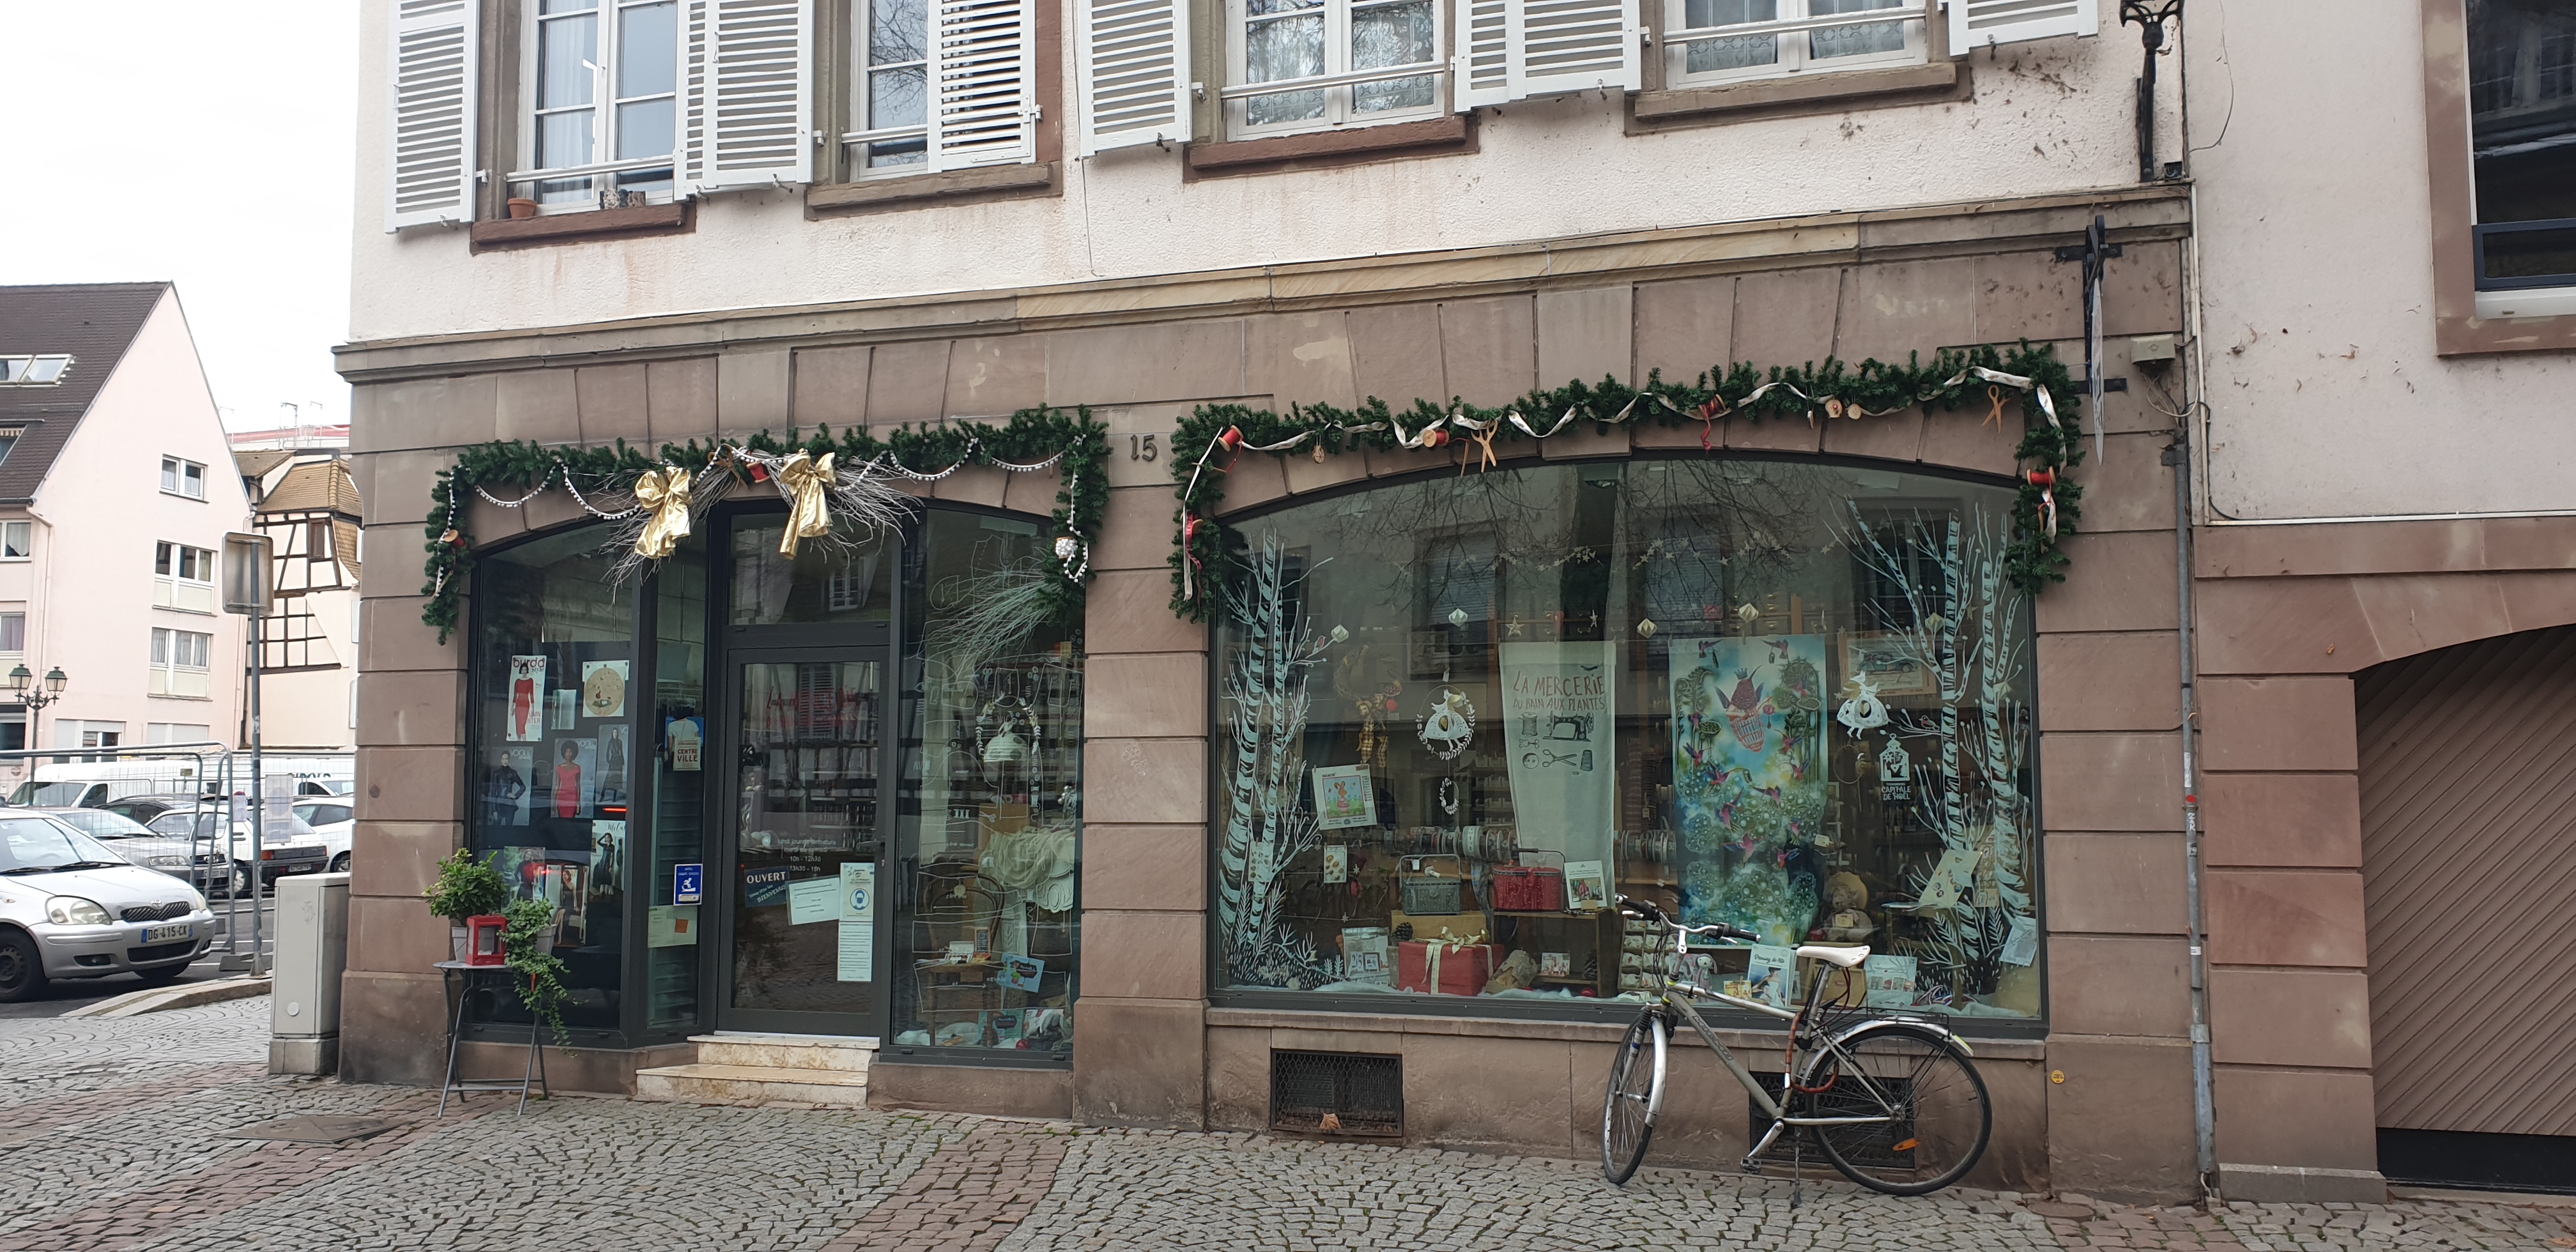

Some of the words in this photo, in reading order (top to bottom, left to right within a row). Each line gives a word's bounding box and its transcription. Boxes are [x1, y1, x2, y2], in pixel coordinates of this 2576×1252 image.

[1130, 434, 1158, 461] 15
[513, 657, 545, 668] burda
[1513, 670, 1529, 694] LA
[1534, 673, 1605, 698] MERCERIE
[1513, 698, 1523, 710] DU
[1525, 698, 1545, 710] BAIN
[1546, 697, 1565, 712] AUX
[1568, 696, 1606, 712] PLANTES
[1883, 793, 1892, 801] DE
[746, 871, 786, 884] OUVERT
